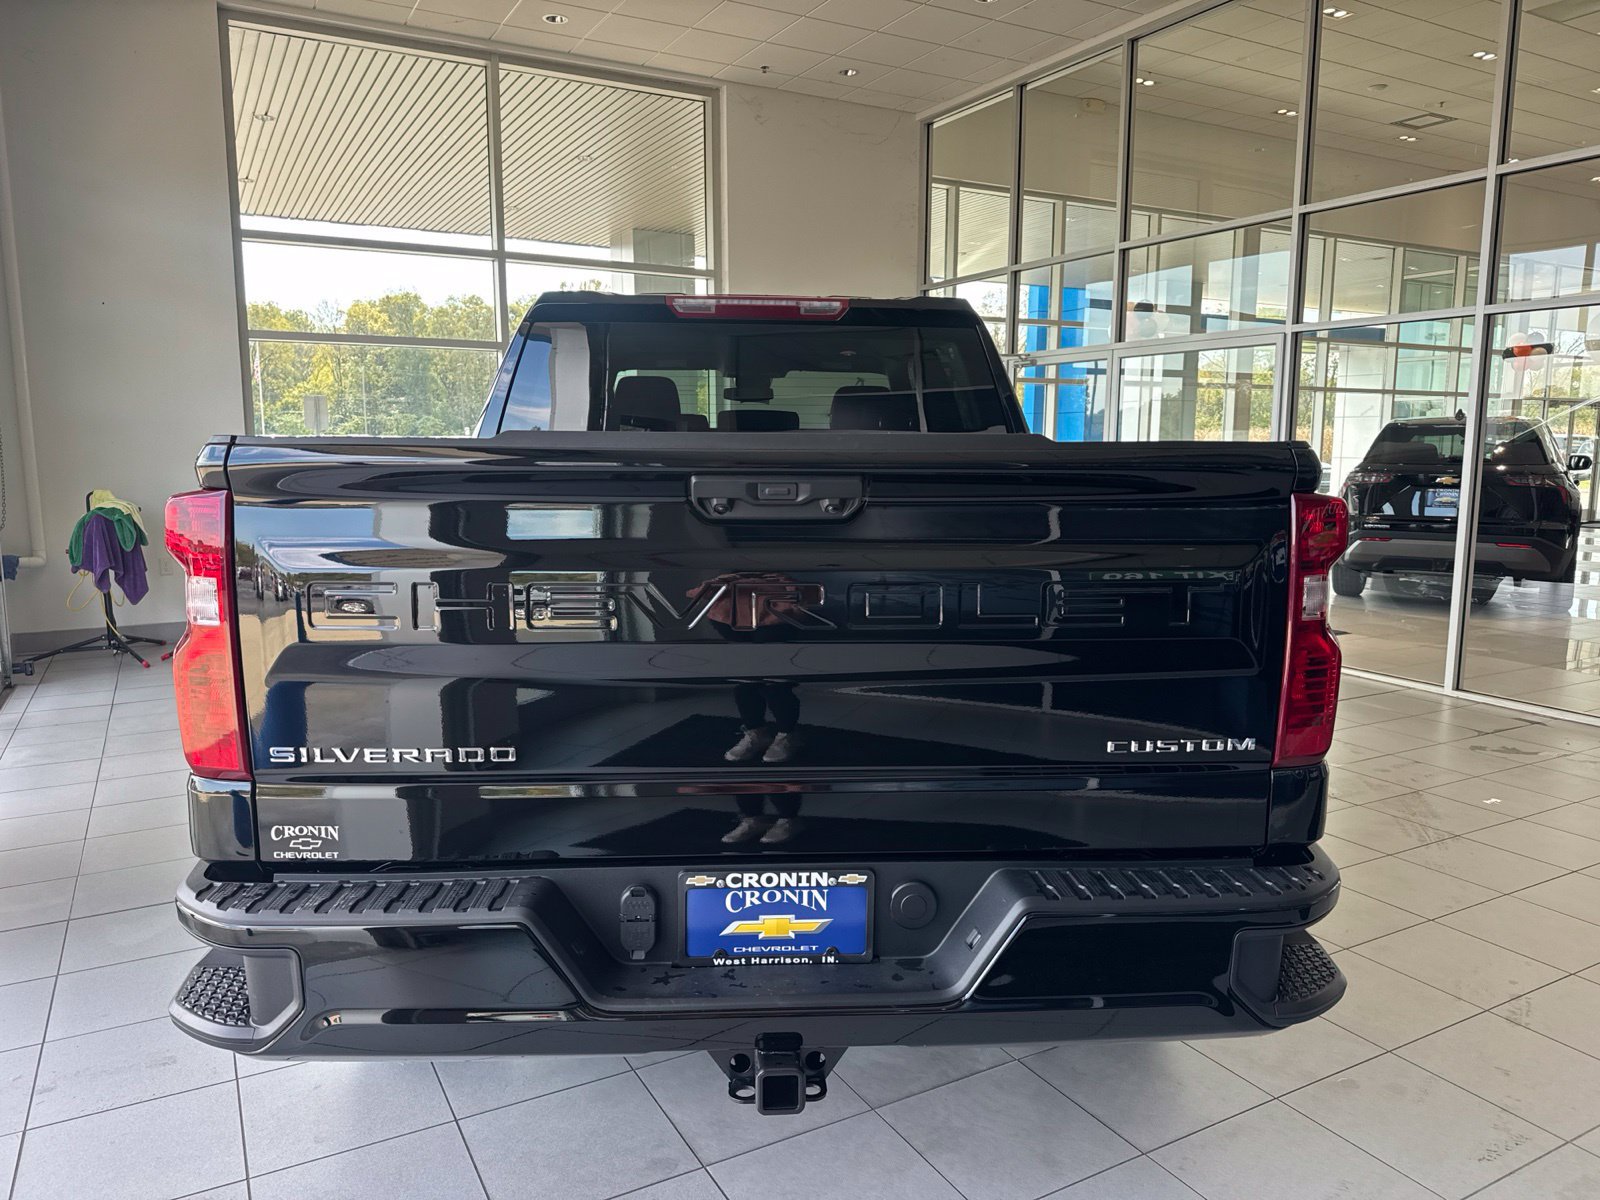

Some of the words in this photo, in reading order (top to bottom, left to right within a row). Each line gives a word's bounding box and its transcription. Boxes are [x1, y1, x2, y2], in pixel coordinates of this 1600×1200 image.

[305, 581, 1225, 631] CHEVROLET
[1106, 738, 1256, 753] CUSTOM
[269, 747, 517, 763] SILVERADO
[270, 825, 339, 842] CRONIN
[273, 851, 339, 860] CHEVROLET
[725, 872, 828, 888] CRONIN
[725, 889, 828, 914] CRONIN
[733, 945, 819, 953] CHEVROLET
[713, 957, 746, 966] West
[751, 956, 813, 965] Harrison,
[821, 956, 839, 964] IN.
